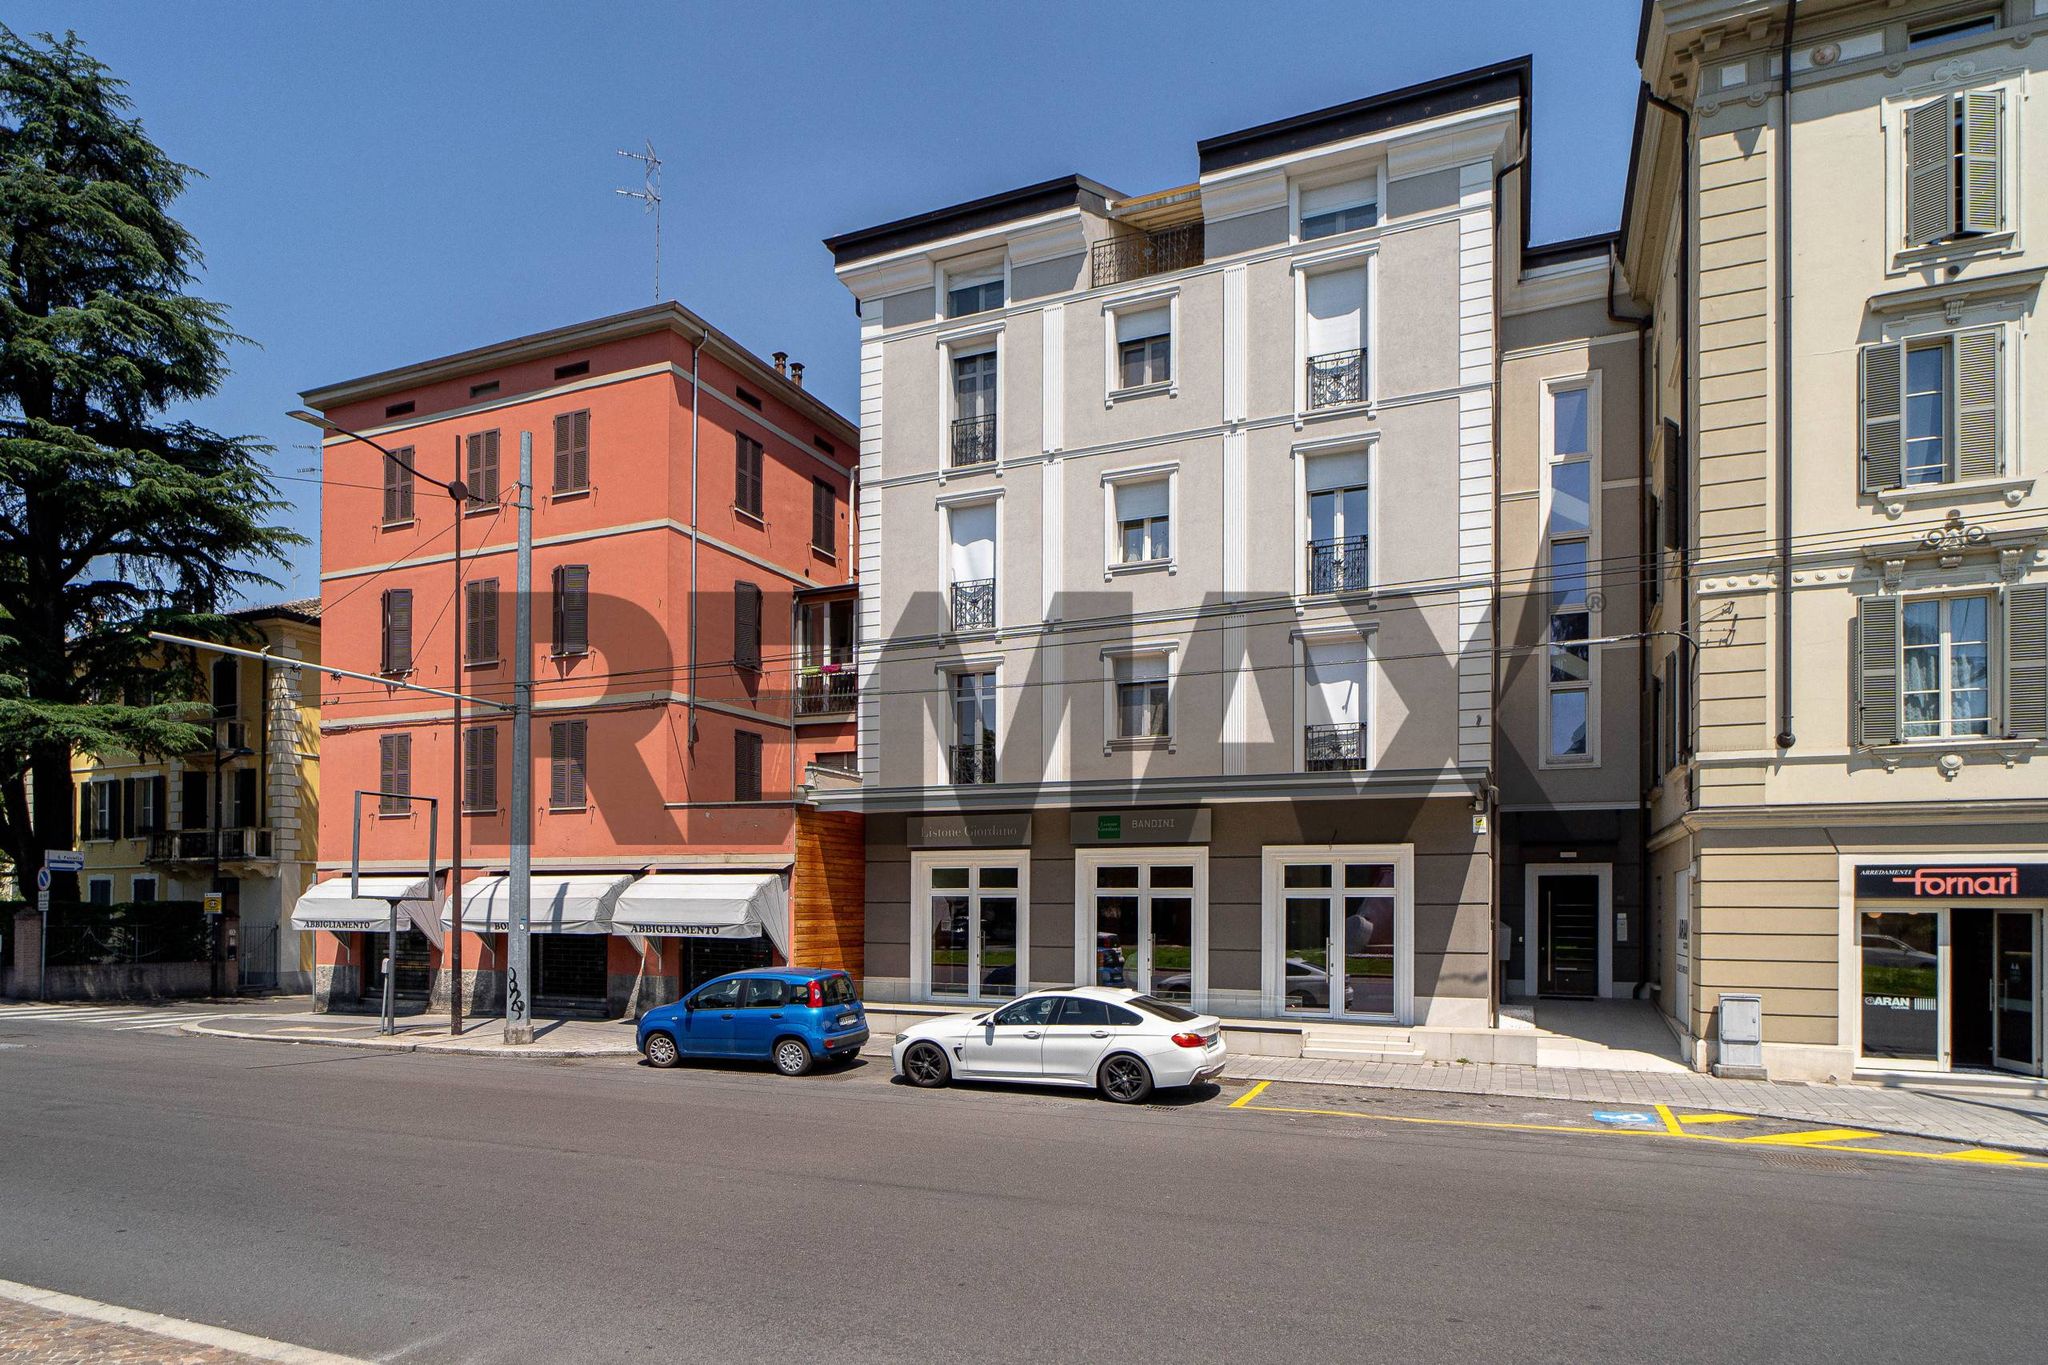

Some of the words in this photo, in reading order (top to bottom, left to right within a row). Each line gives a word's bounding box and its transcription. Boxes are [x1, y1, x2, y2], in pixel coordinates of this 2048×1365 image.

[1132, 819, 1174, 829] BANDINI
[1893, 867, 2018, 896] fornari
[304, 920, 370, 929] ABBIGLIAMENTO
[630, 924, 719, 935] ABBIGLIAMENTO
[1873, 997, 1910, 1006] ARAN
